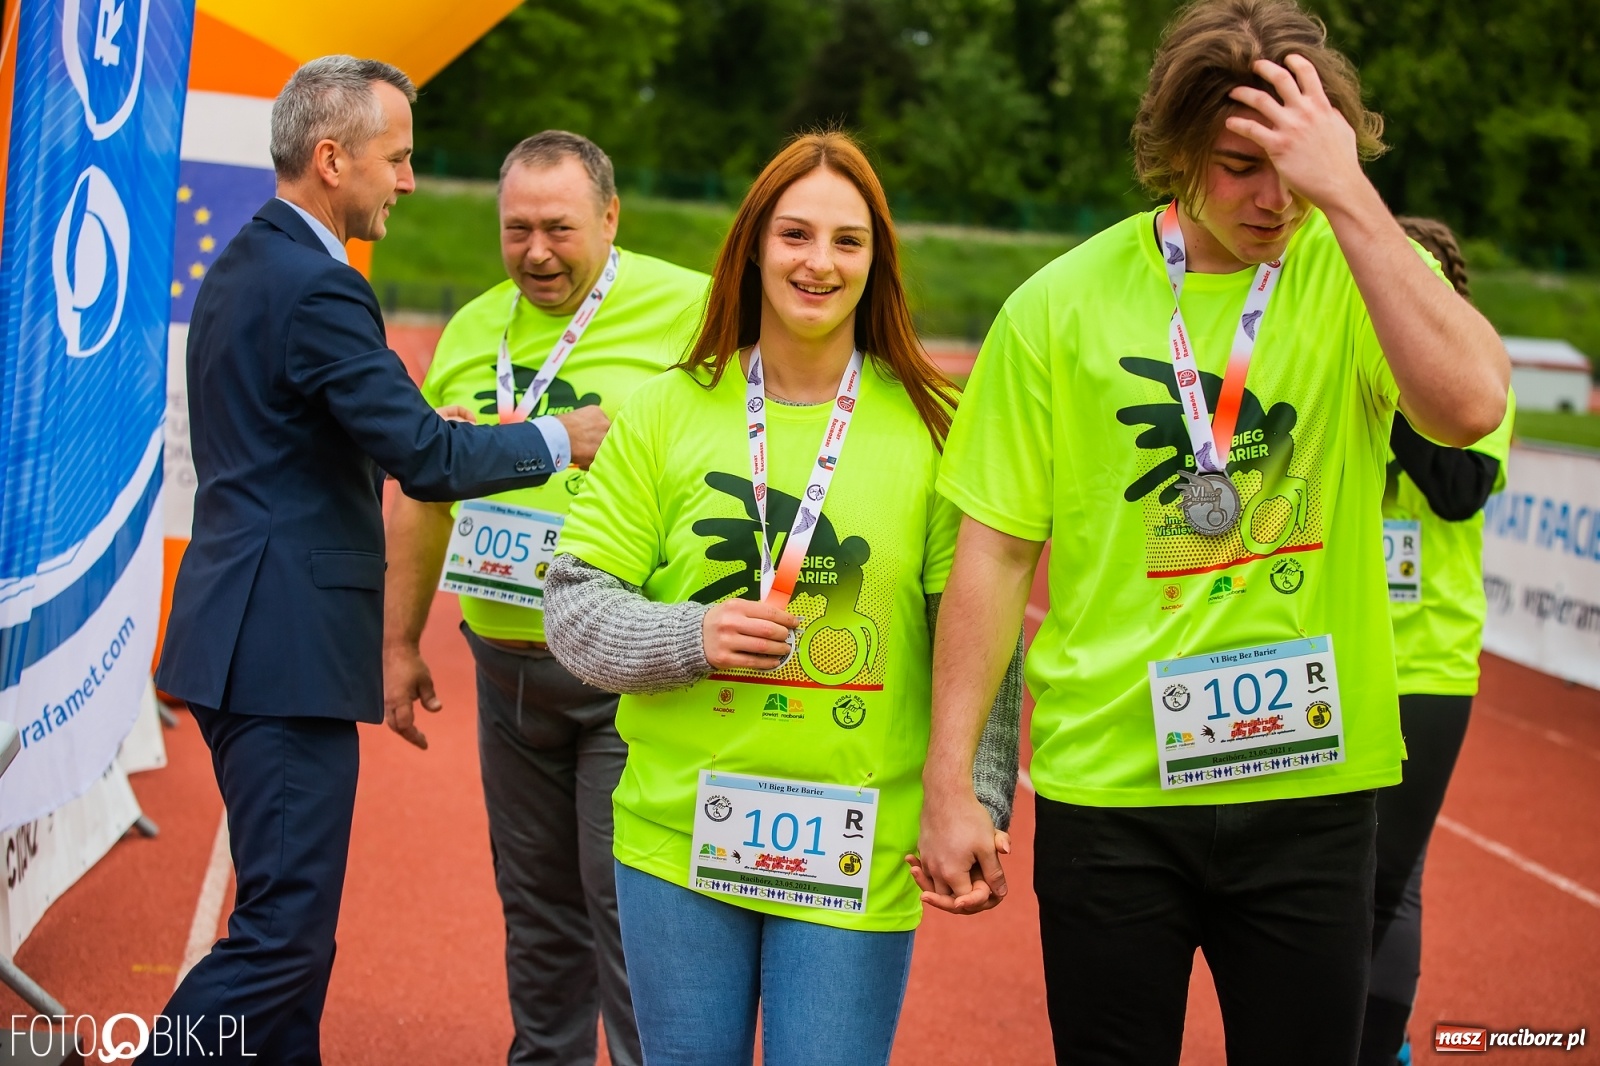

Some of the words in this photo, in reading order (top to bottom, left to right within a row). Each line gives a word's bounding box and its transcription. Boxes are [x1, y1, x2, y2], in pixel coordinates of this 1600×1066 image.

[1227, 445, 1269, 463] ARIER
[475, 525, 531, 563] 005
[544, 530, 557, 546] R
[1403, 535, 1413, 549] R
[796, 571, 838, 584] ARIER
[1210, 656, 1219, 664] VI
[1221, 653, 1238, 663] Bieg
[1239, 651, 1252, 659] Bez
[1253, 647, 1277, 657] Barier
[20, 614, 135, 749] rafamet.com
[1306, 661, 1326, 685] R
[1203, 668, 1293, 721] 102
[1212, 752, 1247, 765] Racibórz,
[1248, 747, 1286, 760] 23.05.2021
[769, 783, 785, 793] Bieg
[787, 785, 799, 793] Bez
[801, 786, 824, 796] Barier
[845, 809, 863, 831] R
[742, 809, 826, 856] 101
[740, 875, 771, 887] Racibórz,
[775, 878, 811, 891] 23.05.2021
